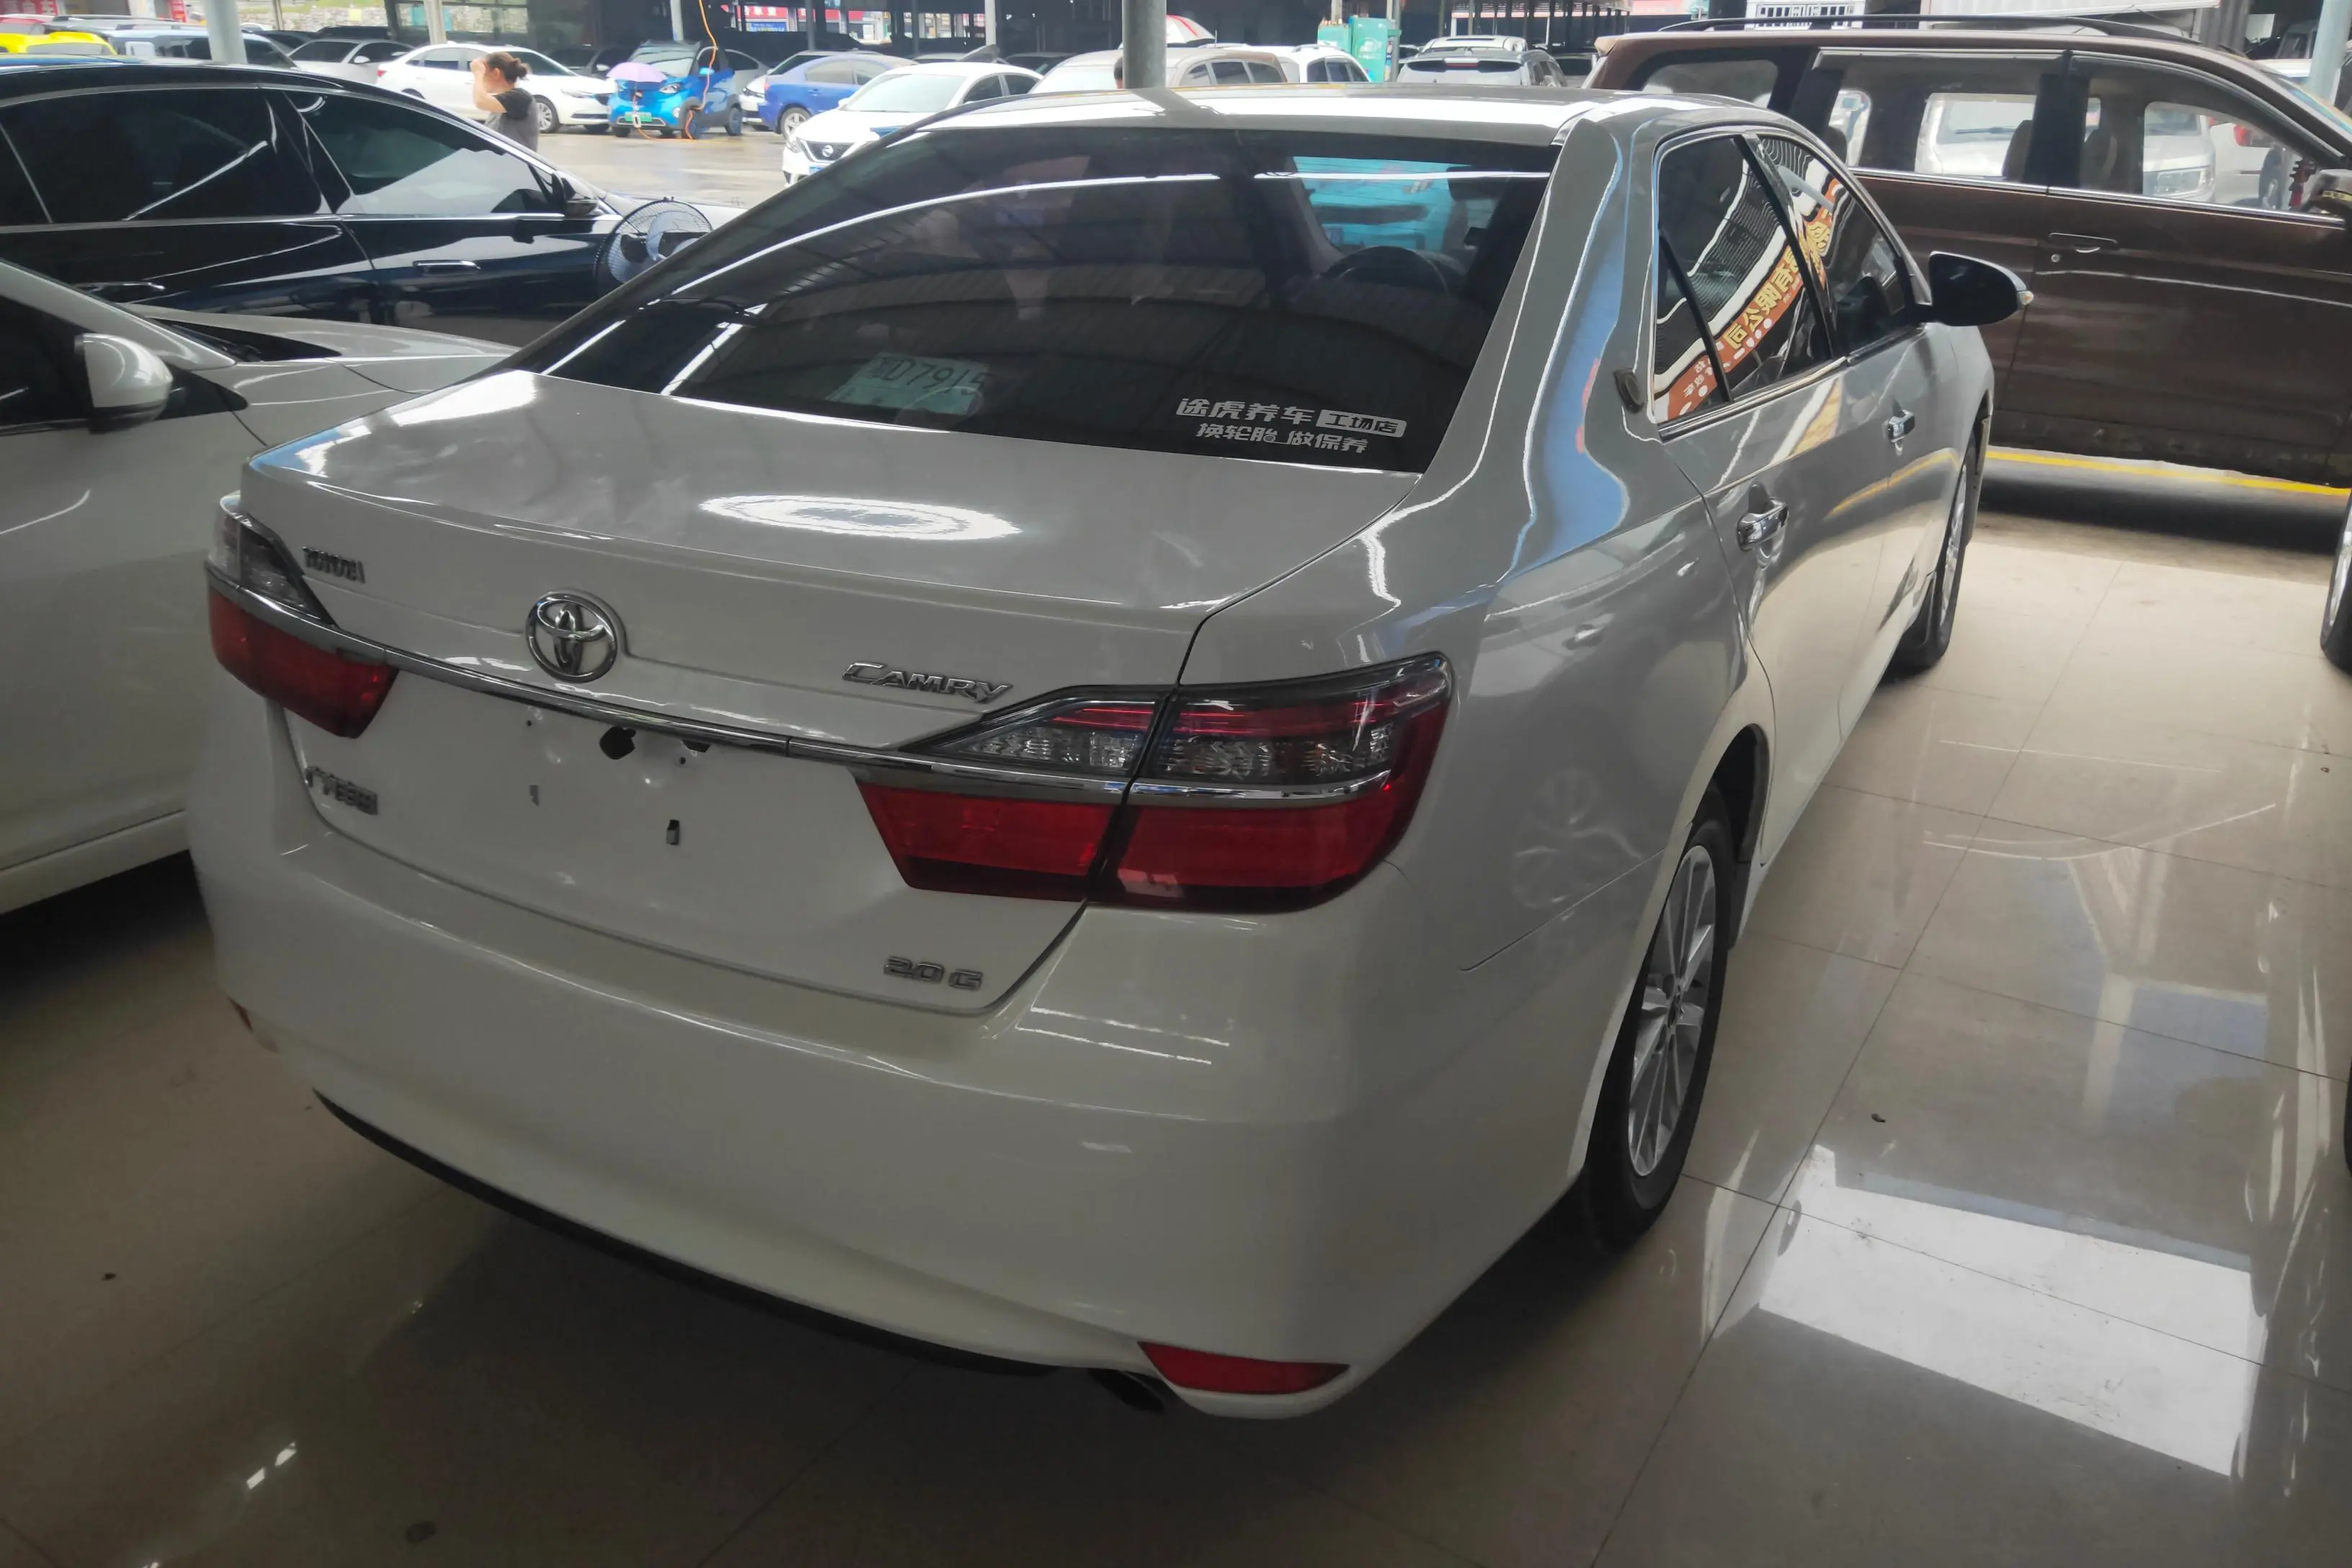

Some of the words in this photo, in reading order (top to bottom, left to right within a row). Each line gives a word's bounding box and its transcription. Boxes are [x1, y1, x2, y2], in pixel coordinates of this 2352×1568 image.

[1176, 398, 1314, 425] 途虎养车
[1324, 411, 1401, 435] 工场店
[1195, 422, 1279, 444] 换轮胎
[1286, 431, 1368, 453] 做保养
[842, 662, 1013, 703] CAMRY
[948, 968, 984, 992] G
